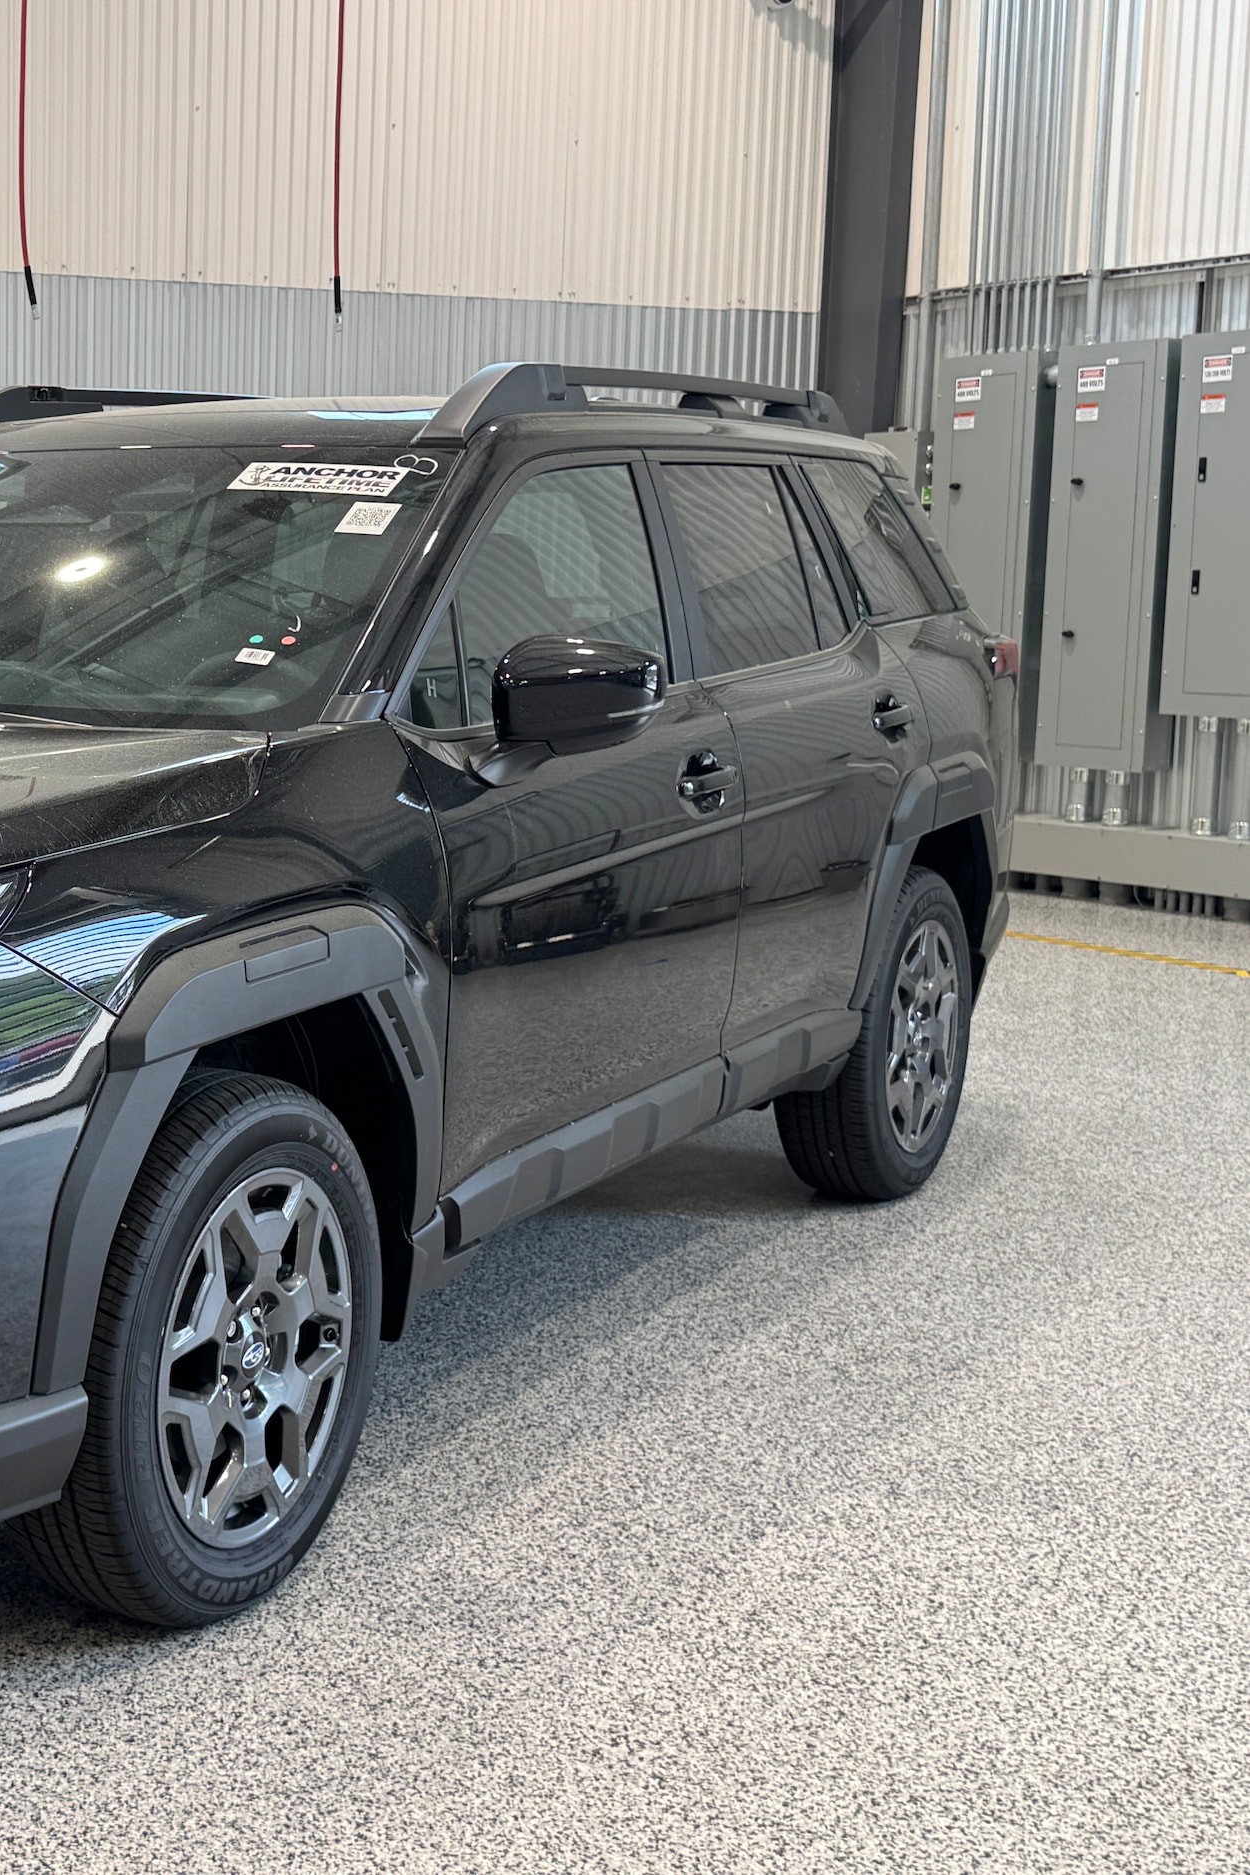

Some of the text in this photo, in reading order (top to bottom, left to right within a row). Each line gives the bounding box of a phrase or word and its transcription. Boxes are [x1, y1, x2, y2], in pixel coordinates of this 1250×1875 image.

[1089, 379, 1103, 387] VOLTS
[966, 389, 980, 397] VOLTS
[271, 466, 402, 481] ANCHOR
[265, 475, 392, 488] LIFETIME
[260, 482, 386, 494] ASSURANCE PLAN
